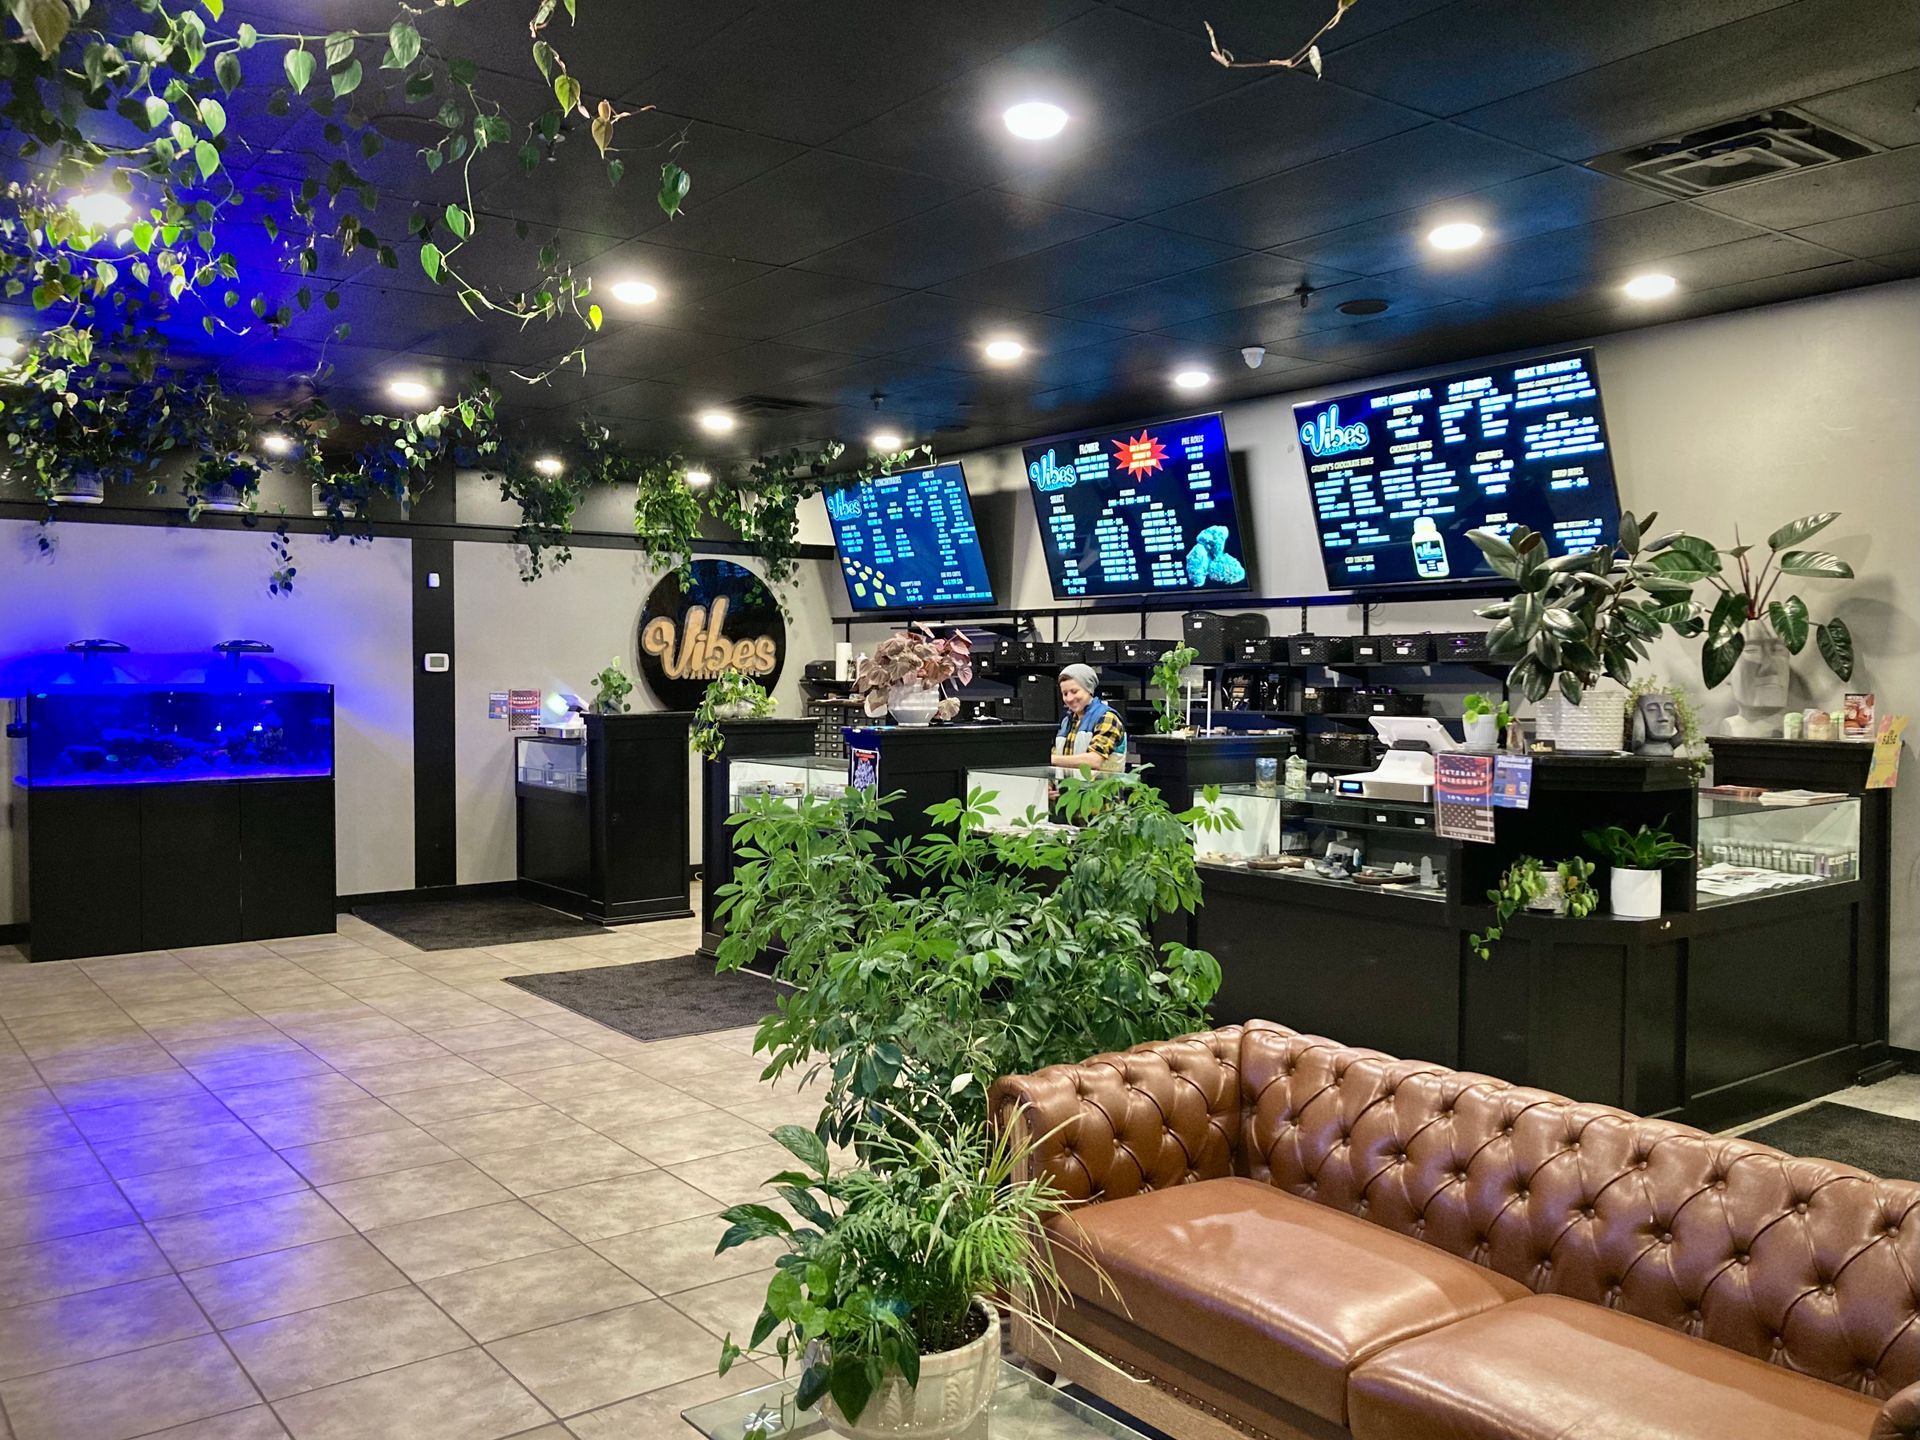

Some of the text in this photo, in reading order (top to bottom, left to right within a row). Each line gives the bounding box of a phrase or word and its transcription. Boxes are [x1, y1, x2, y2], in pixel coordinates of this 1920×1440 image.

[1301, 404, 1369, 456] Vibes
[1030, 448, 1077, 491] Vibes
[827, 489, 862, 520] Vibes
[642, 595, 776, 679] Vibes
[1440, 768, 1486, 779] VETERAN'S
[1441, 777, 1484, 786] DISCOUNT
